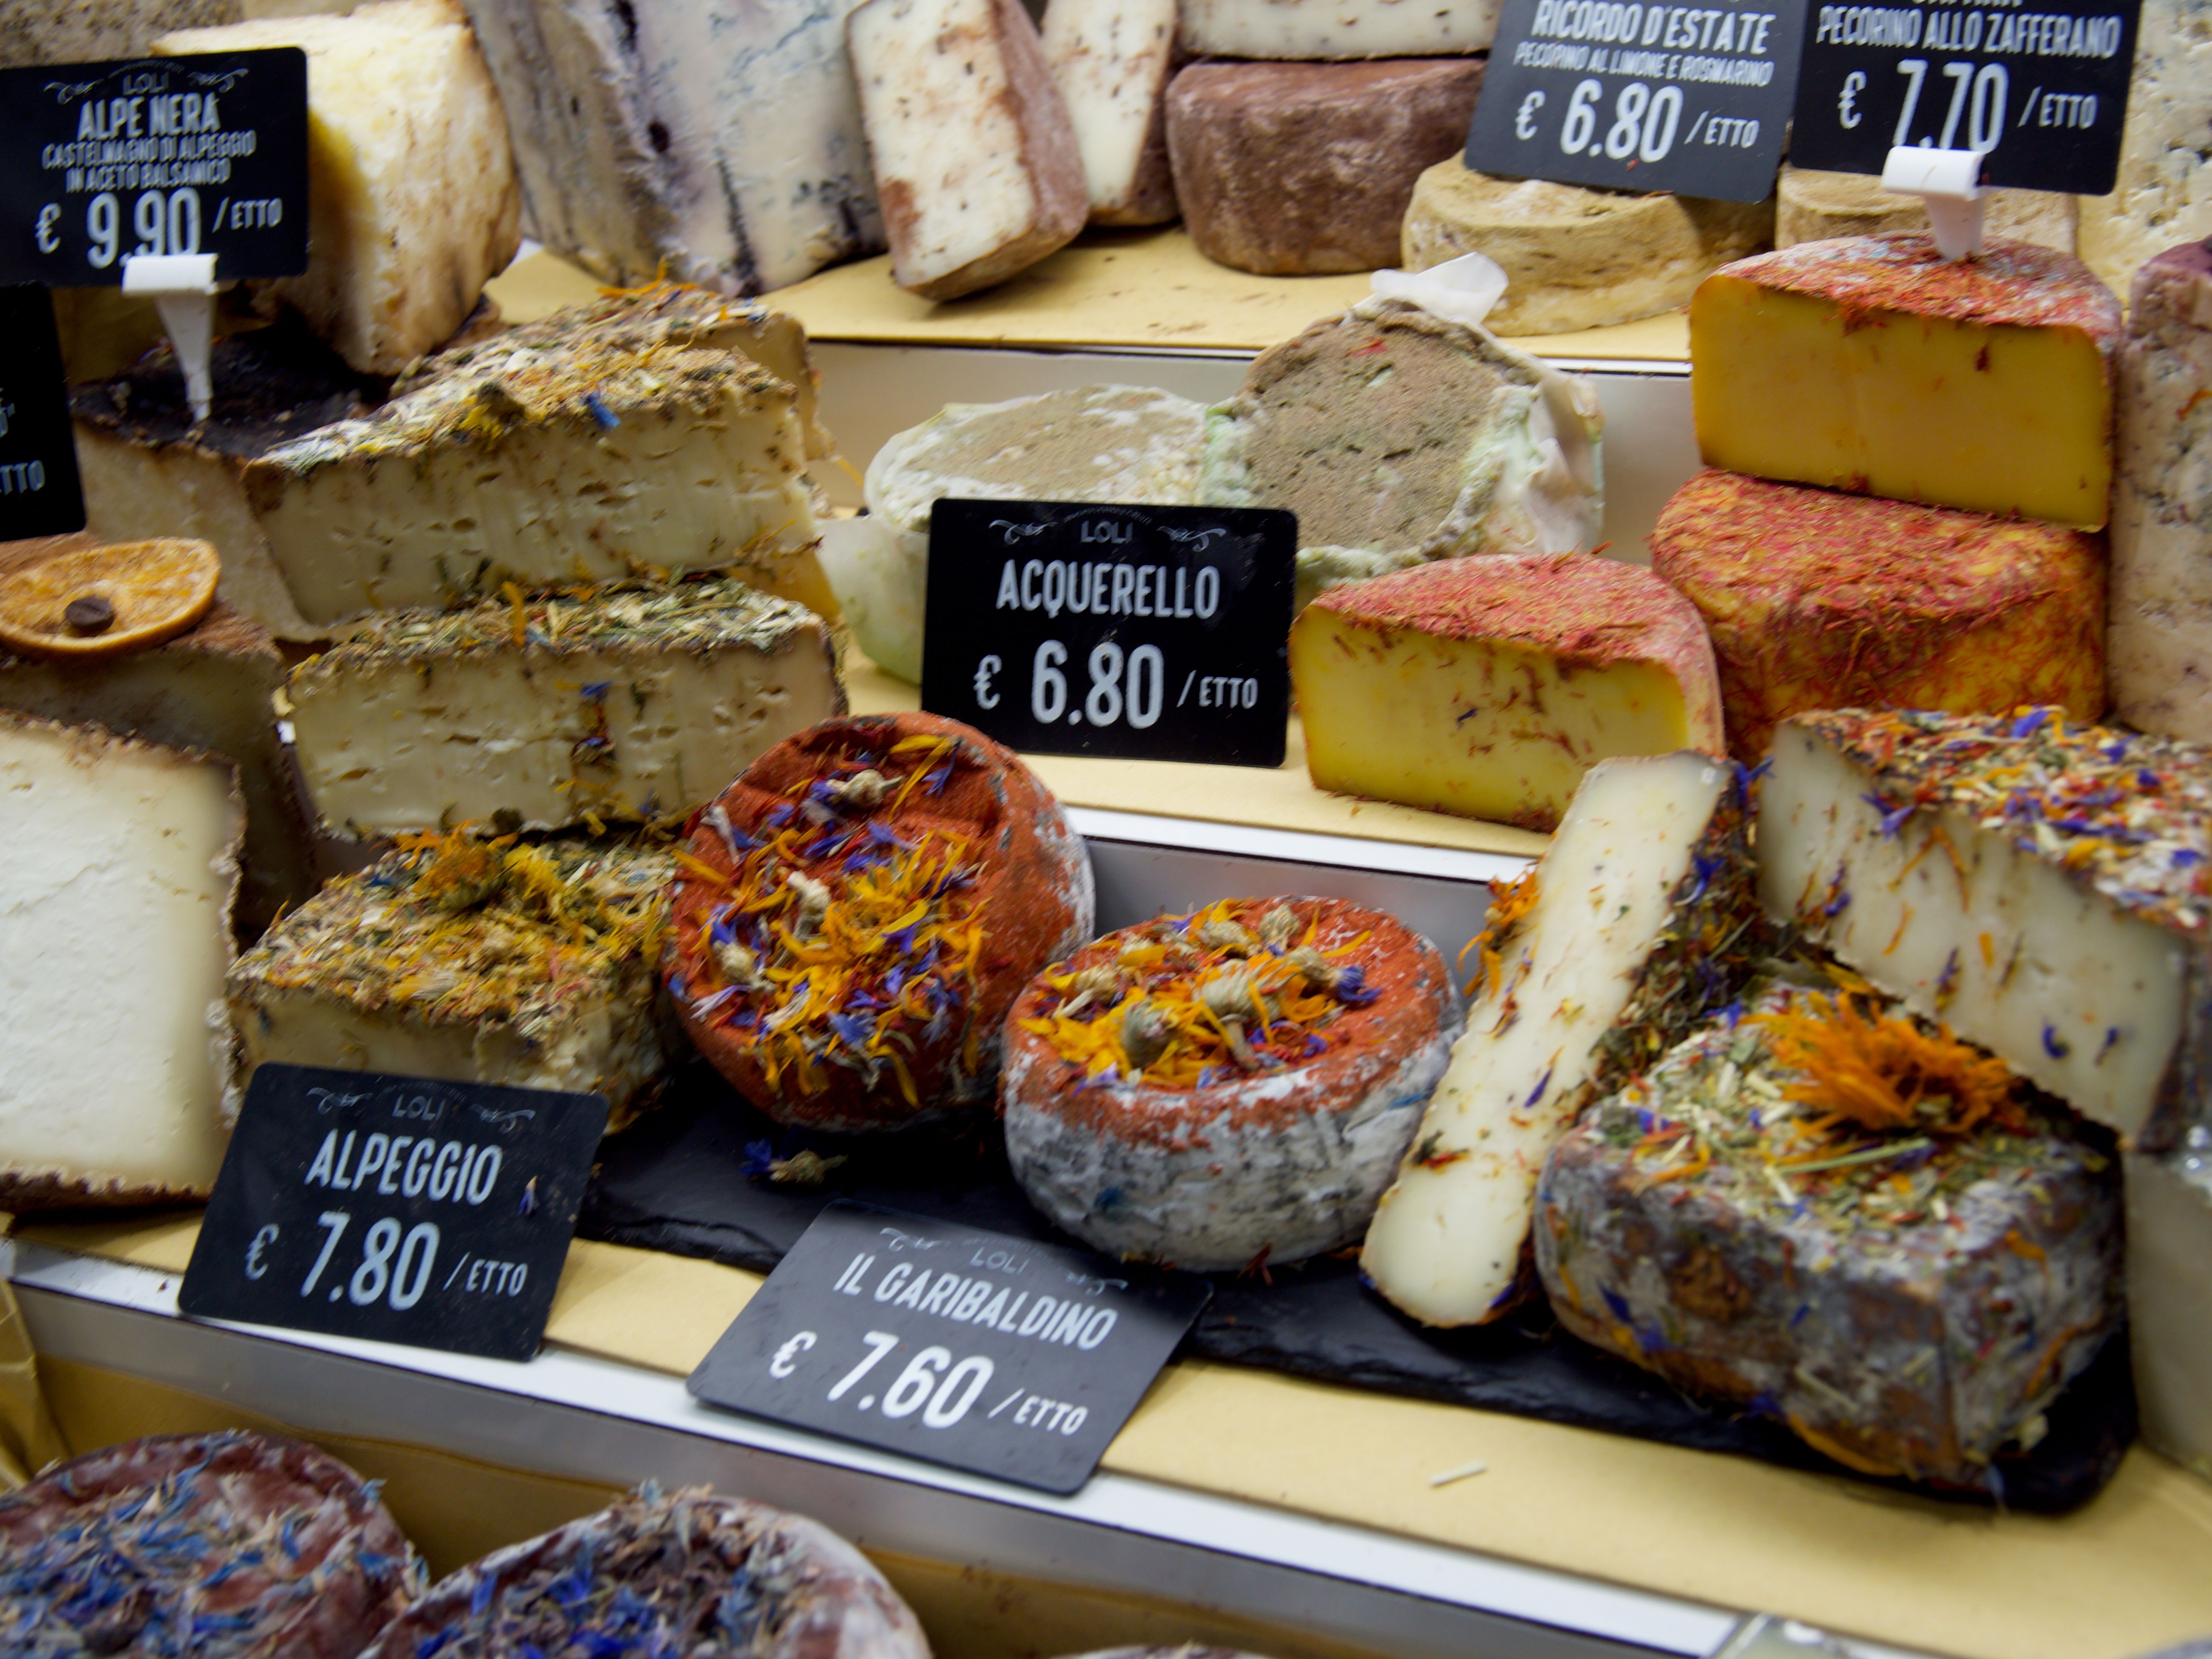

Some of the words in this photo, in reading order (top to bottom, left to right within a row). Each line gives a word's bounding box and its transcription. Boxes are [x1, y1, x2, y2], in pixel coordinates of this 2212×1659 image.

[1531, 0, 1643, 44] RICORDO
[1640, 5, 1777, 55] D'ESTATE
[1816, 5, 1923, 48] PECORINO
[1921, 11, 1982, 51] ALLO
[1983, 13, 2123, 59] ZAFFERANO
[122, 73, 169, 96] LOLI
[1513, 41, 1591, 71] PECORINO
[1586, 48, 1610, 73] AL
[1608, 49, 1670, 79] LIMONE
[1665, 54, 1683, 80] E
[1678, 55, 1775, 87] ROSMARINO
[77, 96, 145, 142] ALPE
[148, 92, 221, 137] NERA
[1560, 79, 1684, 163] 6.80
[1892, 59, 2010, 154] 7.70
[42, 137, 159, 169] CASTELMAGNO
[159, 136, 178, 163] DI
[178, 129, 256, 160] ALPEGGIO
[66, 167, 84, 193] IN
[85, 163, 140, 192] ACETO
[140, 157, 232, 189] BALSAMICO
[87, 187, 201, 269] 9.90
[0, 460, 46, 496] TTO
[1080, 520, 1133, 544] LOLI
[996, 559, 1221, 619] ACQUERELLO
[1031, 640, 1165, 729] 6.80
[391, 1093, 447, 1121] LOLI
[305, 1128, 503, 1205] ALPEGGIO
[300, 1211, 440, 1311] 7.80
[969, 1246, 1030, 1275] LOLI
[833, 1253, 875, 1295] IL
[874, 1262, 1118, 1350] GARIBALDINO
[827, 1330, 994, 1429] 7.60
